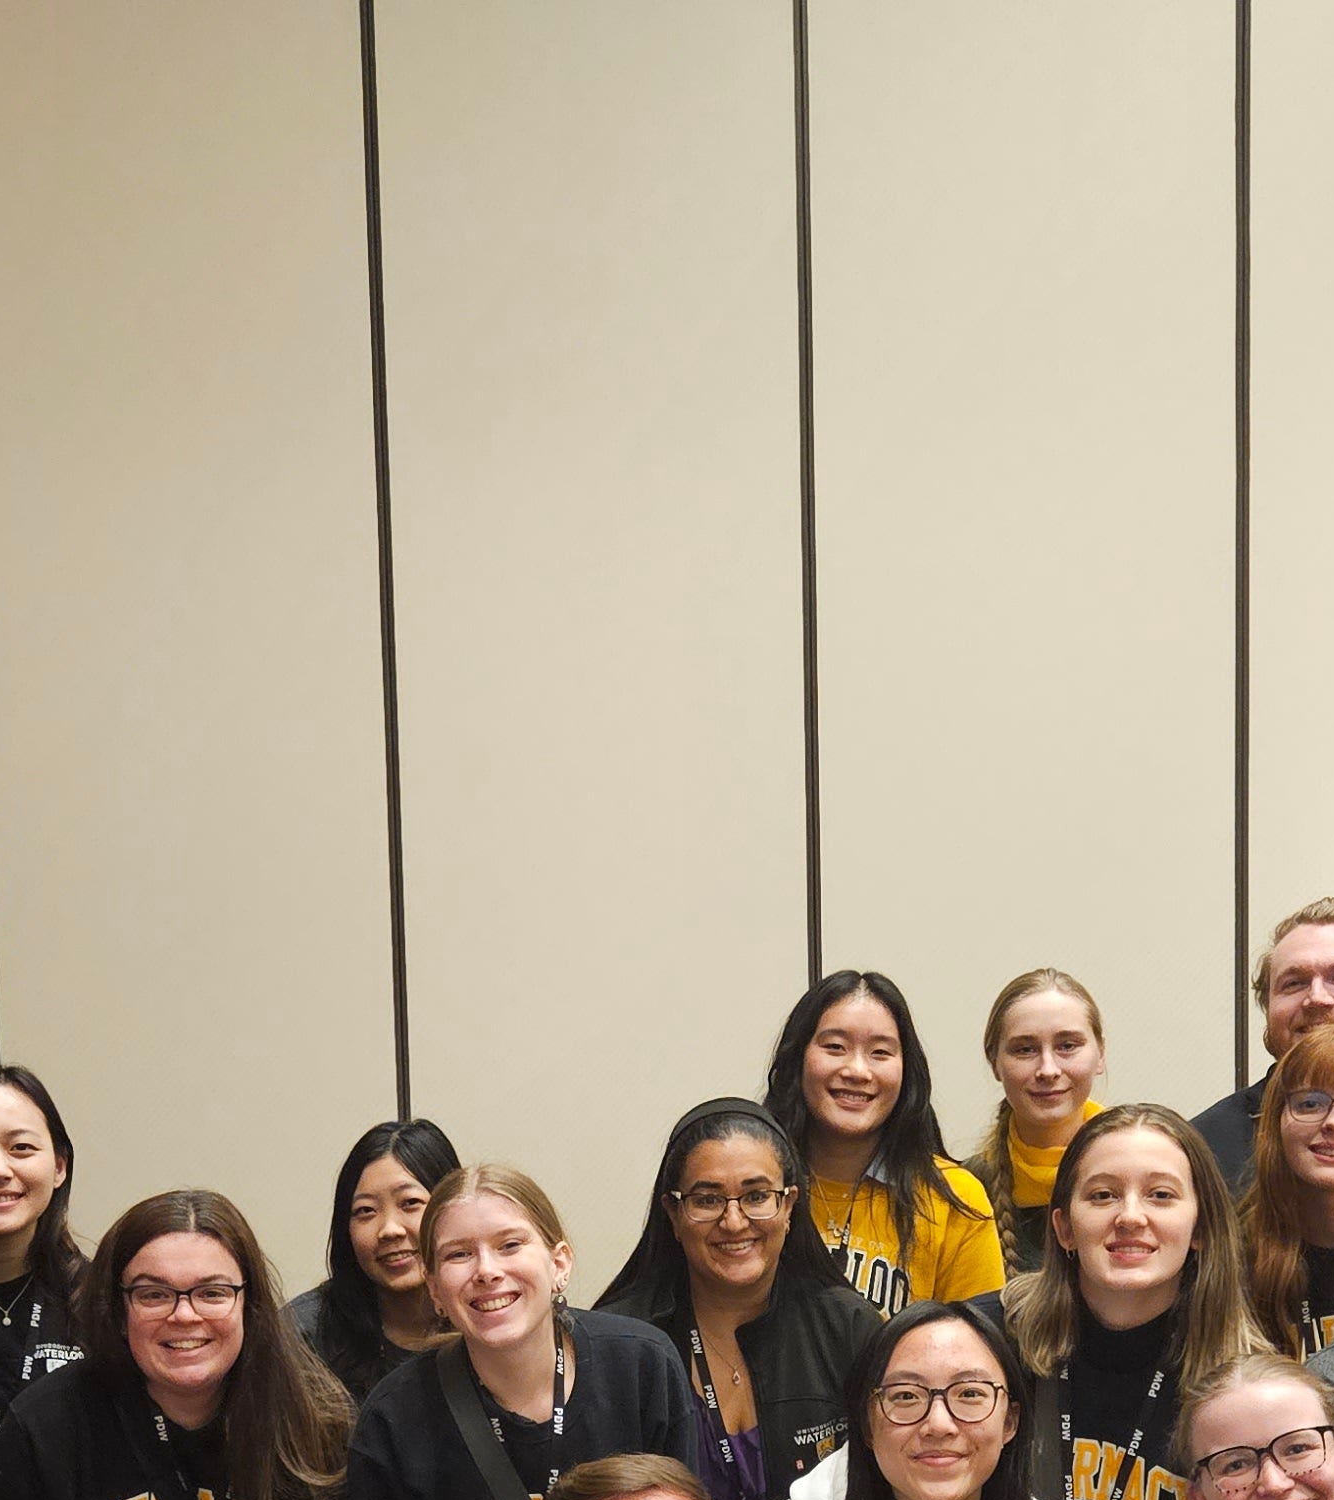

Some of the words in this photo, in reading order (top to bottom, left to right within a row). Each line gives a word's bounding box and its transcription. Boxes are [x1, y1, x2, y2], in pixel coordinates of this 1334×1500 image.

[31, 1303, 42, 1327] PDW
[690, 1330, 702, 1354] PDW
[22, 1356, 34, 1380] PDW
[704, 1385, 717, 1409] PDW
[1148, 1371, 1164, 1398] PDW
[154, 1415, 168, 1441] PDW
[554, 1408, 563, 1435] PDW
[1061, 1414, 1070, 1441] PDW
[719, 1439, 734, 1463] PDW
[1128, 1429, 1144, 1456] PDW
[1065, 1475, 1073, 1500] PDW
